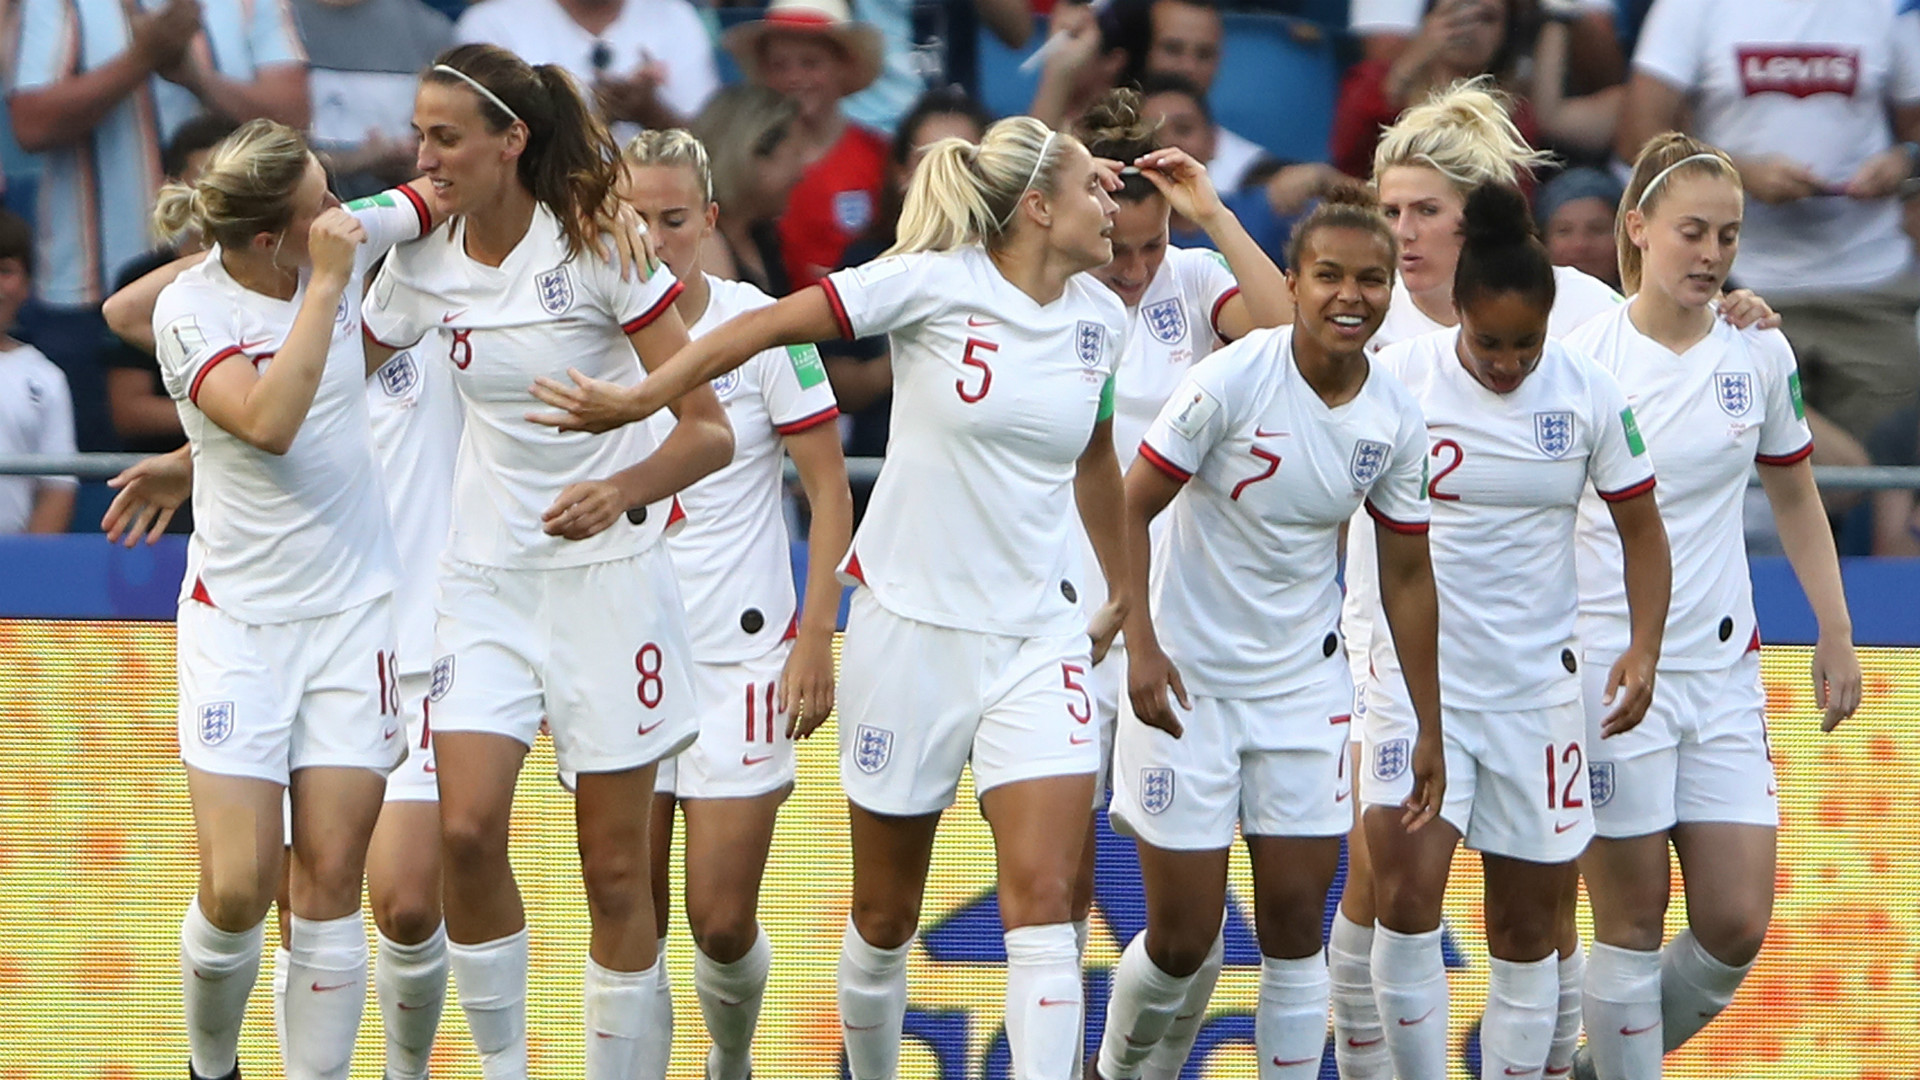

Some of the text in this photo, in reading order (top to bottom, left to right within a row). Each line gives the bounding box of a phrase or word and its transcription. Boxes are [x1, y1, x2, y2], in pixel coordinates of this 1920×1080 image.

[450, 327, 472, 371] 8
[955, 336, 1000, 404] 5
[1229, 444, 1282, 502] 7
[1428, 438, 1464, 501] 2
[377, 648, 400, 717] 18
[635, 641, 663, 709] 8
[1061, 661, 1092, 725] 5
[745, 681, 775, 744] 11
[1328, 713, 1352, 779] 7
[1545, 741, 1584, 810] 12
